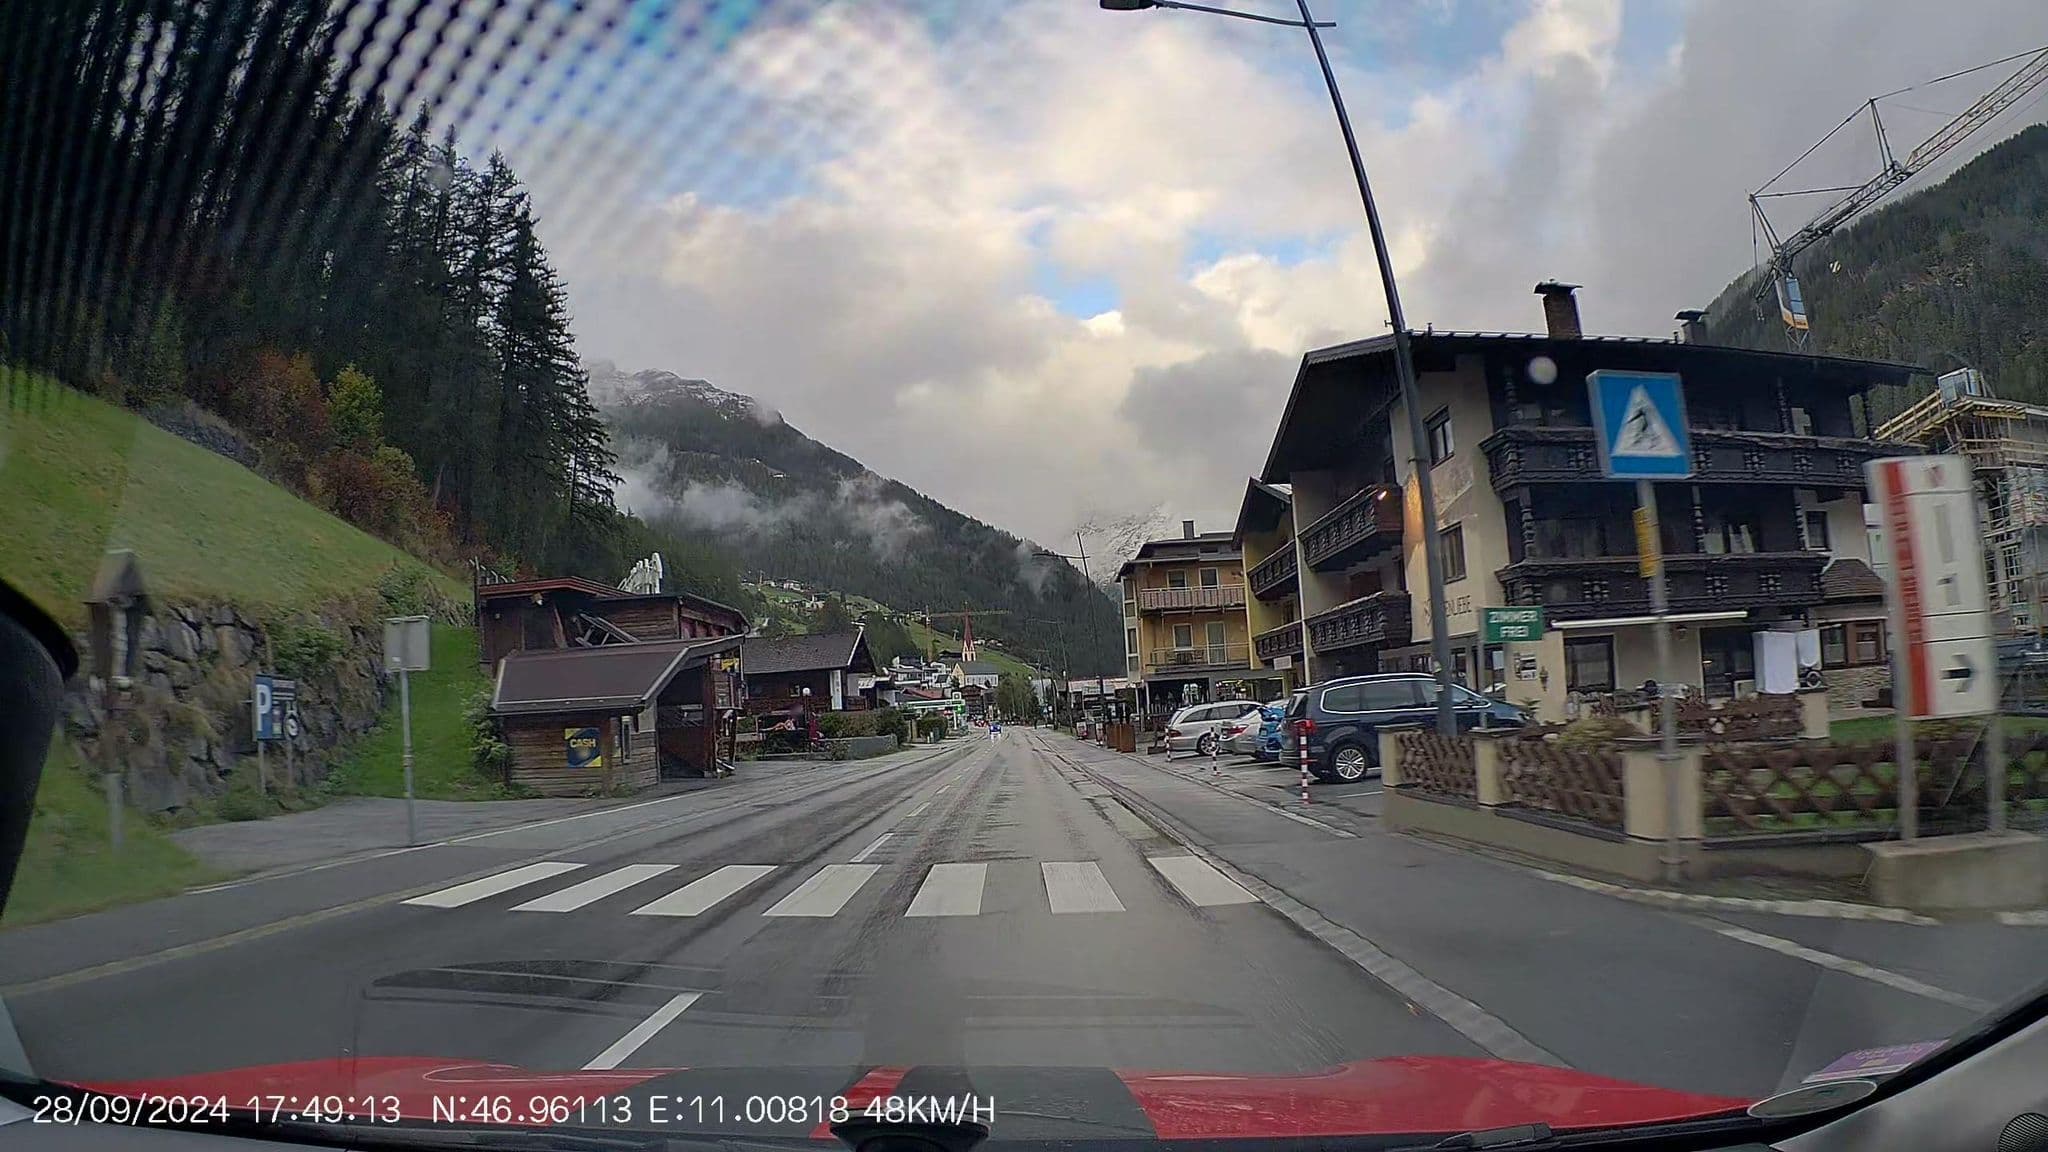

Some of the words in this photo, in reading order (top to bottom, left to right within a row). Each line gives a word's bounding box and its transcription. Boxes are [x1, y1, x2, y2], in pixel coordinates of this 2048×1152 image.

[1488, 610, 1539, 623] ZIMMER
[1500, 625, 1529, 638] FREI
[256, 684, 271, 732] P
[569, 738, 597, 748] CASH
